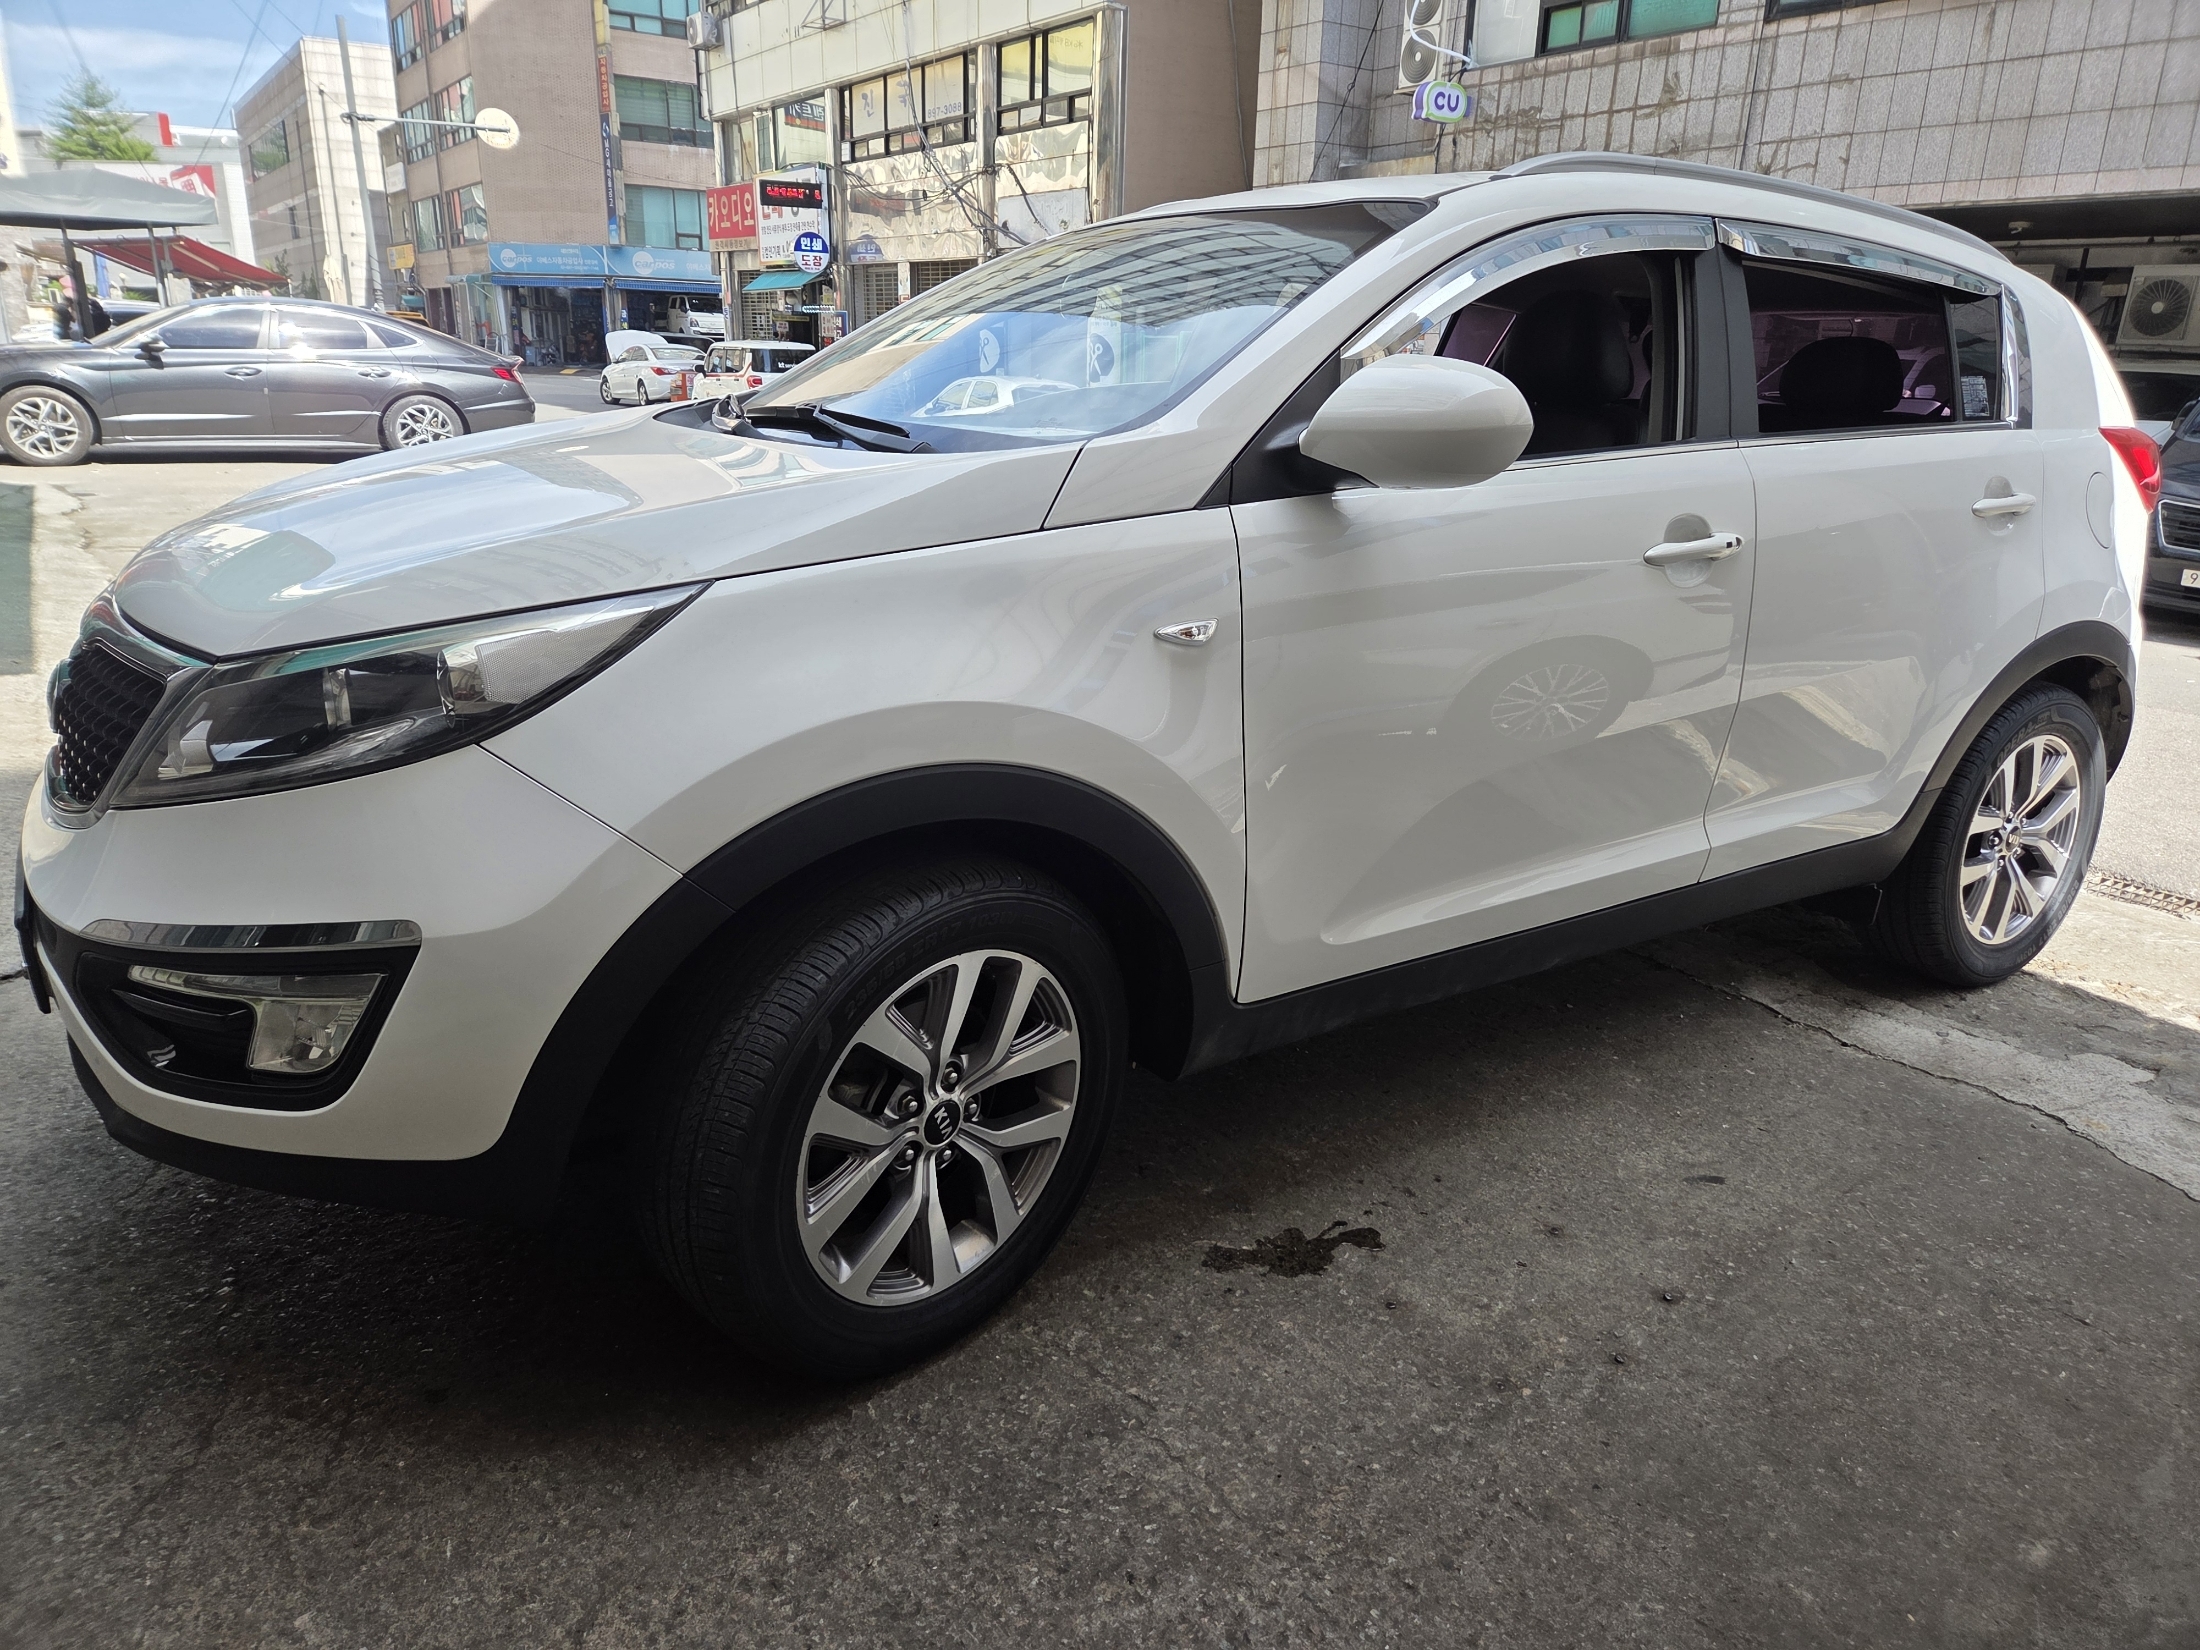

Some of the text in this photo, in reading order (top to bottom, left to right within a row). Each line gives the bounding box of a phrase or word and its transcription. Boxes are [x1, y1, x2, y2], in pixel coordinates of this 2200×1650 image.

[927, 101, 963, 119] 897-3088
[1434, 91, 1460, 113] CU
[708, 189, 755, 233] 카오디오
[800, 237, 823, 251] 인쇄
[634, 260, 676, 270] carpos
[801, 254, 822, 267] 도장
[2190, 572, 2199, 585] 9
[934, 1106, 953, 1140] KIA
